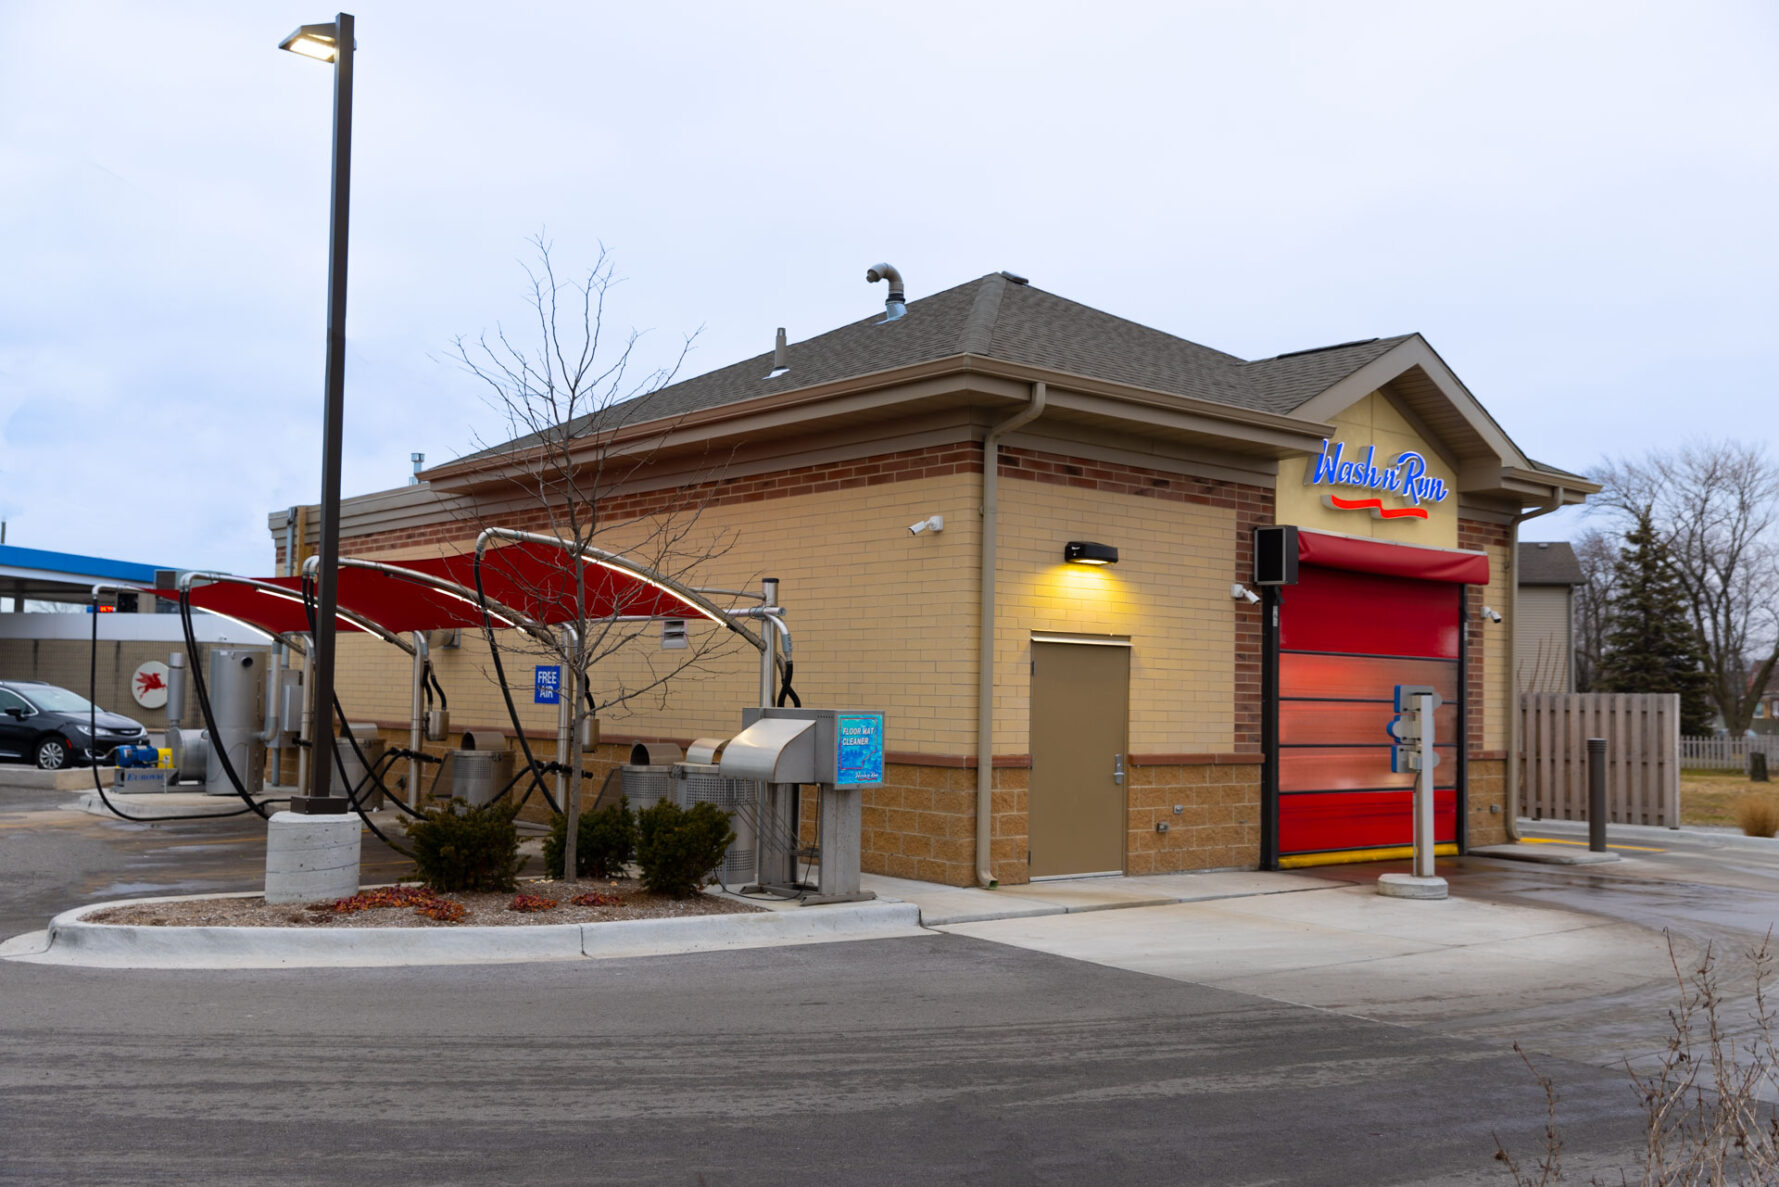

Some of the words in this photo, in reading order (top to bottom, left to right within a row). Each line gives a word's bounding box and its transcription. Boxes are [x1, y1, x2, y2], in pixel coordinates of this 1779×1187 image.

[1313, 438, 1382, 488] Wash
[1397, 451, 1449, 506] Run
[537, 671, 557, 684] FREE
[539, 685, 554, 698] AIR
[842, 727, 861, 735] FLOOR
[842, 737, 869, 746] CLEANER
